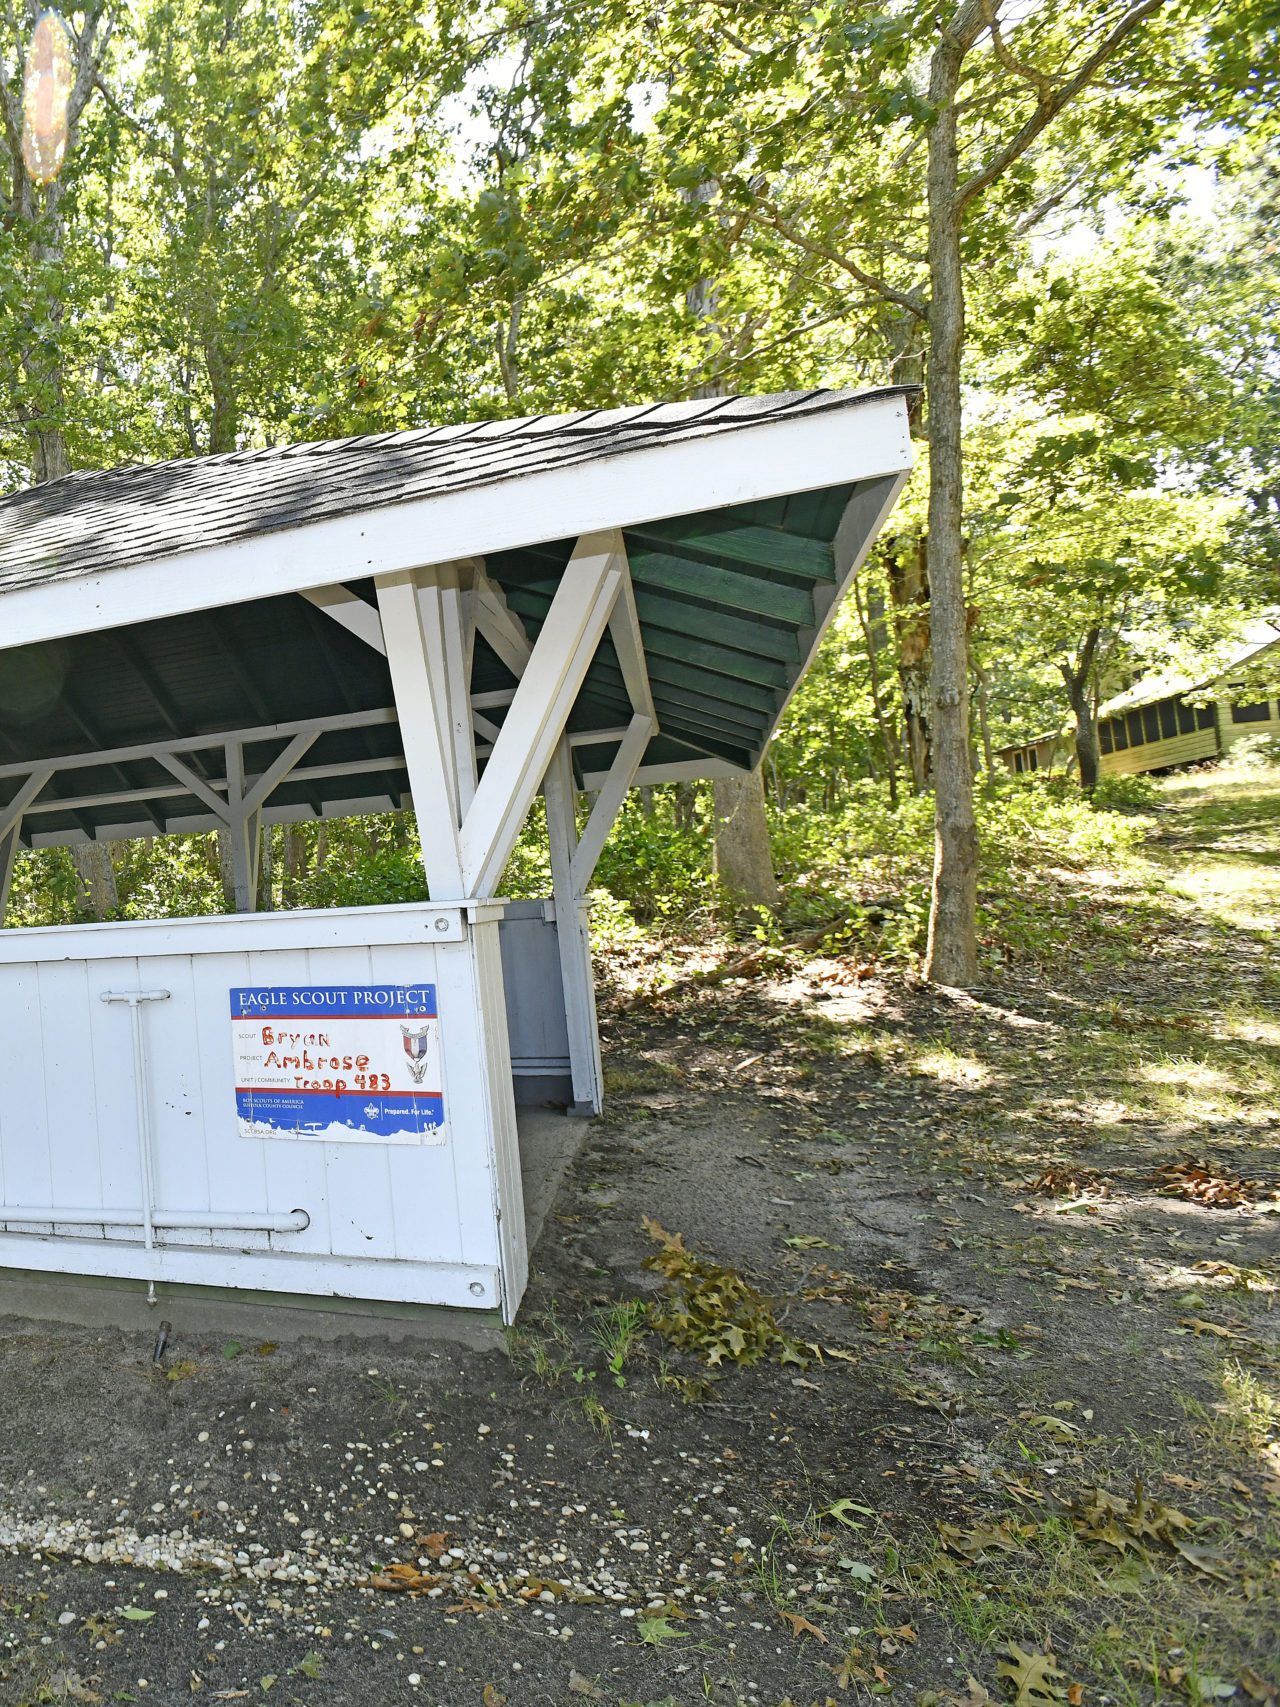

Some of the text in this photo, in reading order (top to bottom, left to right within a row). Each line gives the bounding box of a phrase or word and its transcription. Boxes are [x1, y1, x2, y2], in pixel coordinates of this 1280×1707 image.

[239, 990, 429, 1007] EAGLE SCOUT PROJECT
[264, 1050, 370, 1072] Ambrose
[294, 1073, 391, 1099] Troop 483
